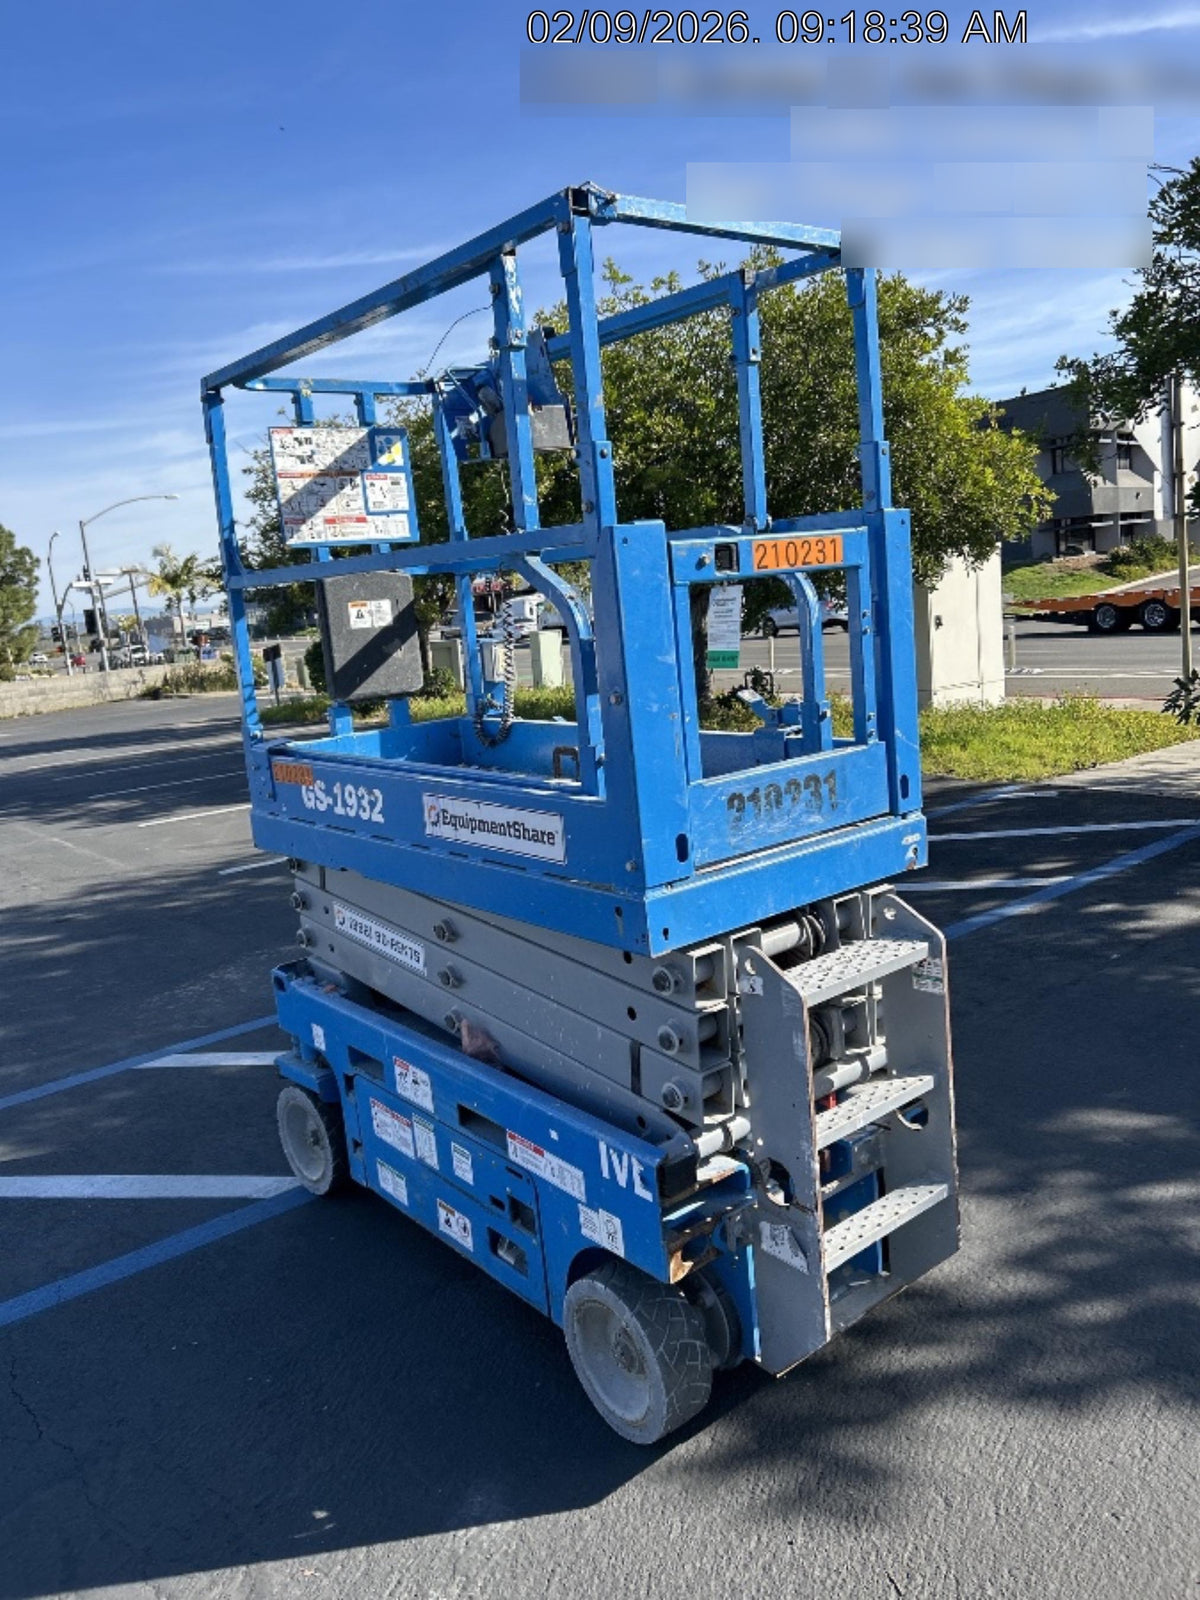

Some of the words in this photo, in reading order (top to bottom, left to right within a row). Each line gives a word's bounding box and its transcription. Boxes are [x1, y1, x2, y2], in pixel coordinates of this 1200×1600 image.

[755, 538, 838, 570] 210231
[301, 780, 385, 824] GS-1932
[441, 808, 556, 846] EquipmentShare
